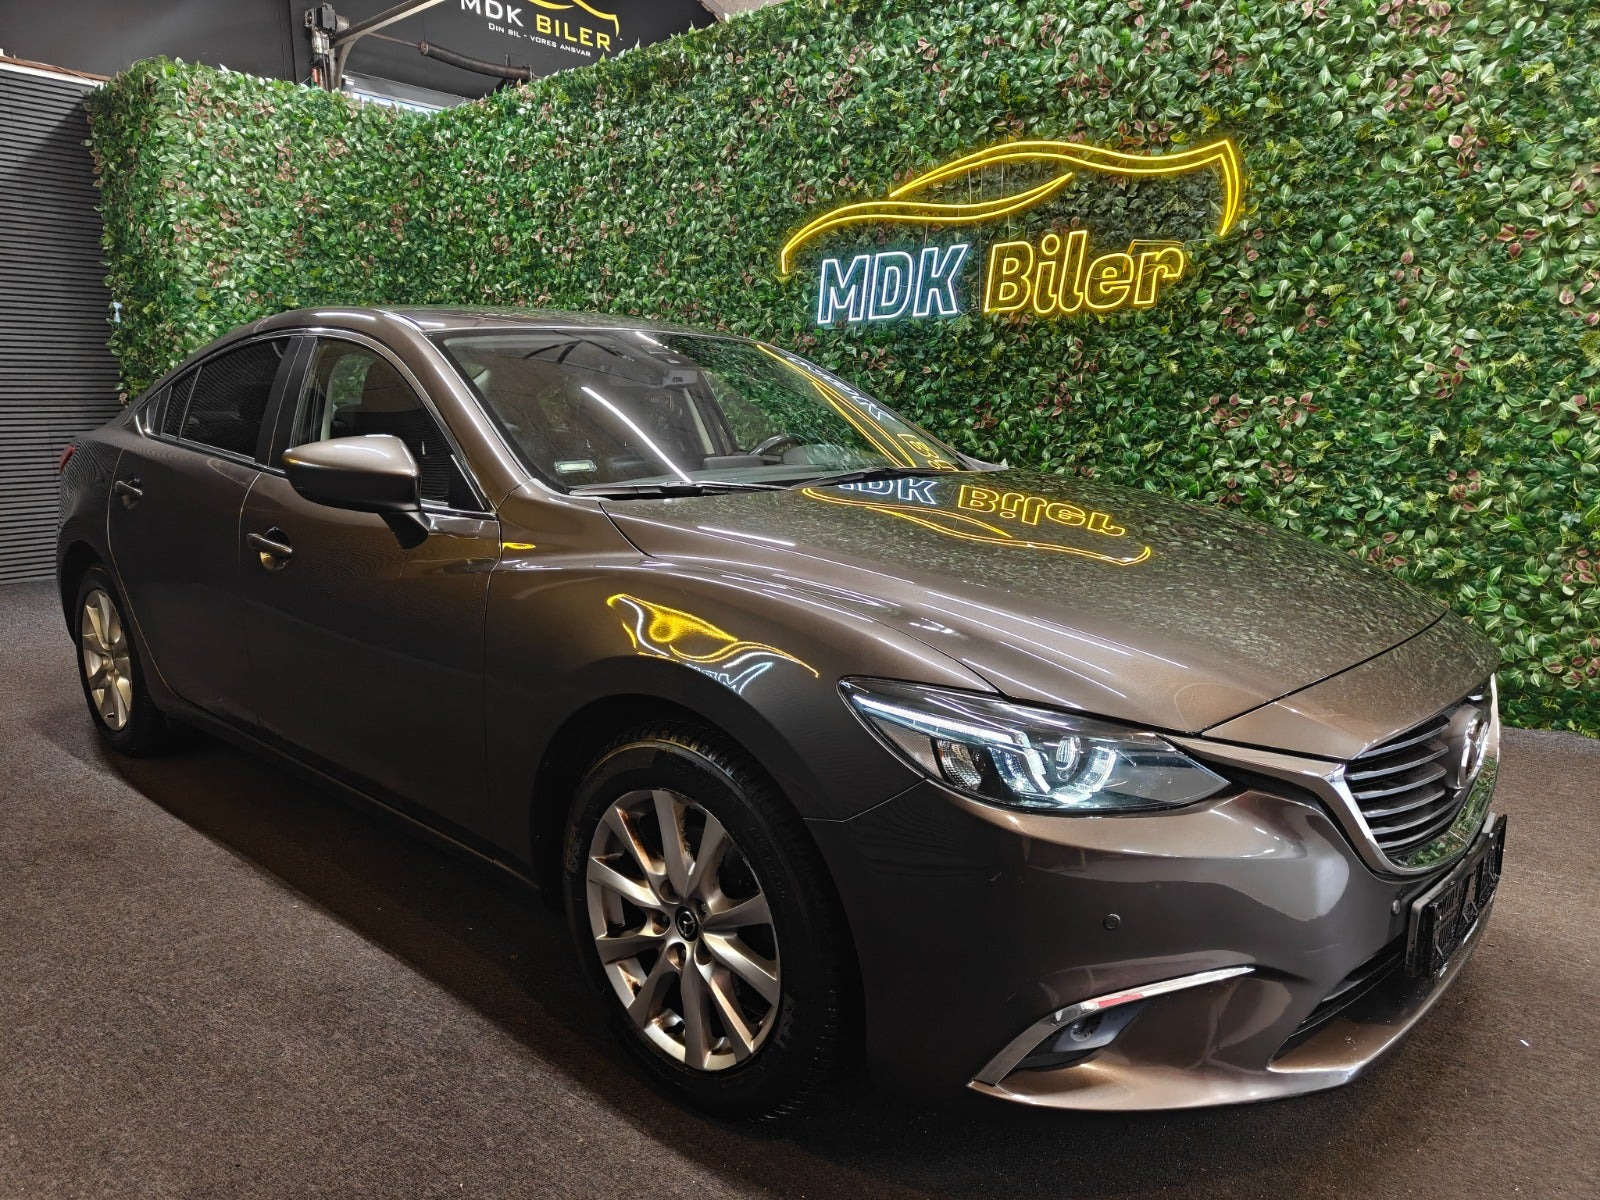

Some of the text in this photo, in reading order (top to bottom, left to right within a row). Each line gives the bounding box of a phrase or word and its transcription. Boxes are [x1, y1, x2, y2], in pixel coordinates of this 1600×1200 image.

[460, 0, 612, 52] MDK BILER
[488, 22, 505, 34] DIN
[507, 29, 521, 38] BIL
[530, 35, 557, 48] VORES
[560, 44, 591, 57] ANSVAR
[817, 229, 1185, 324] MDK Biler
